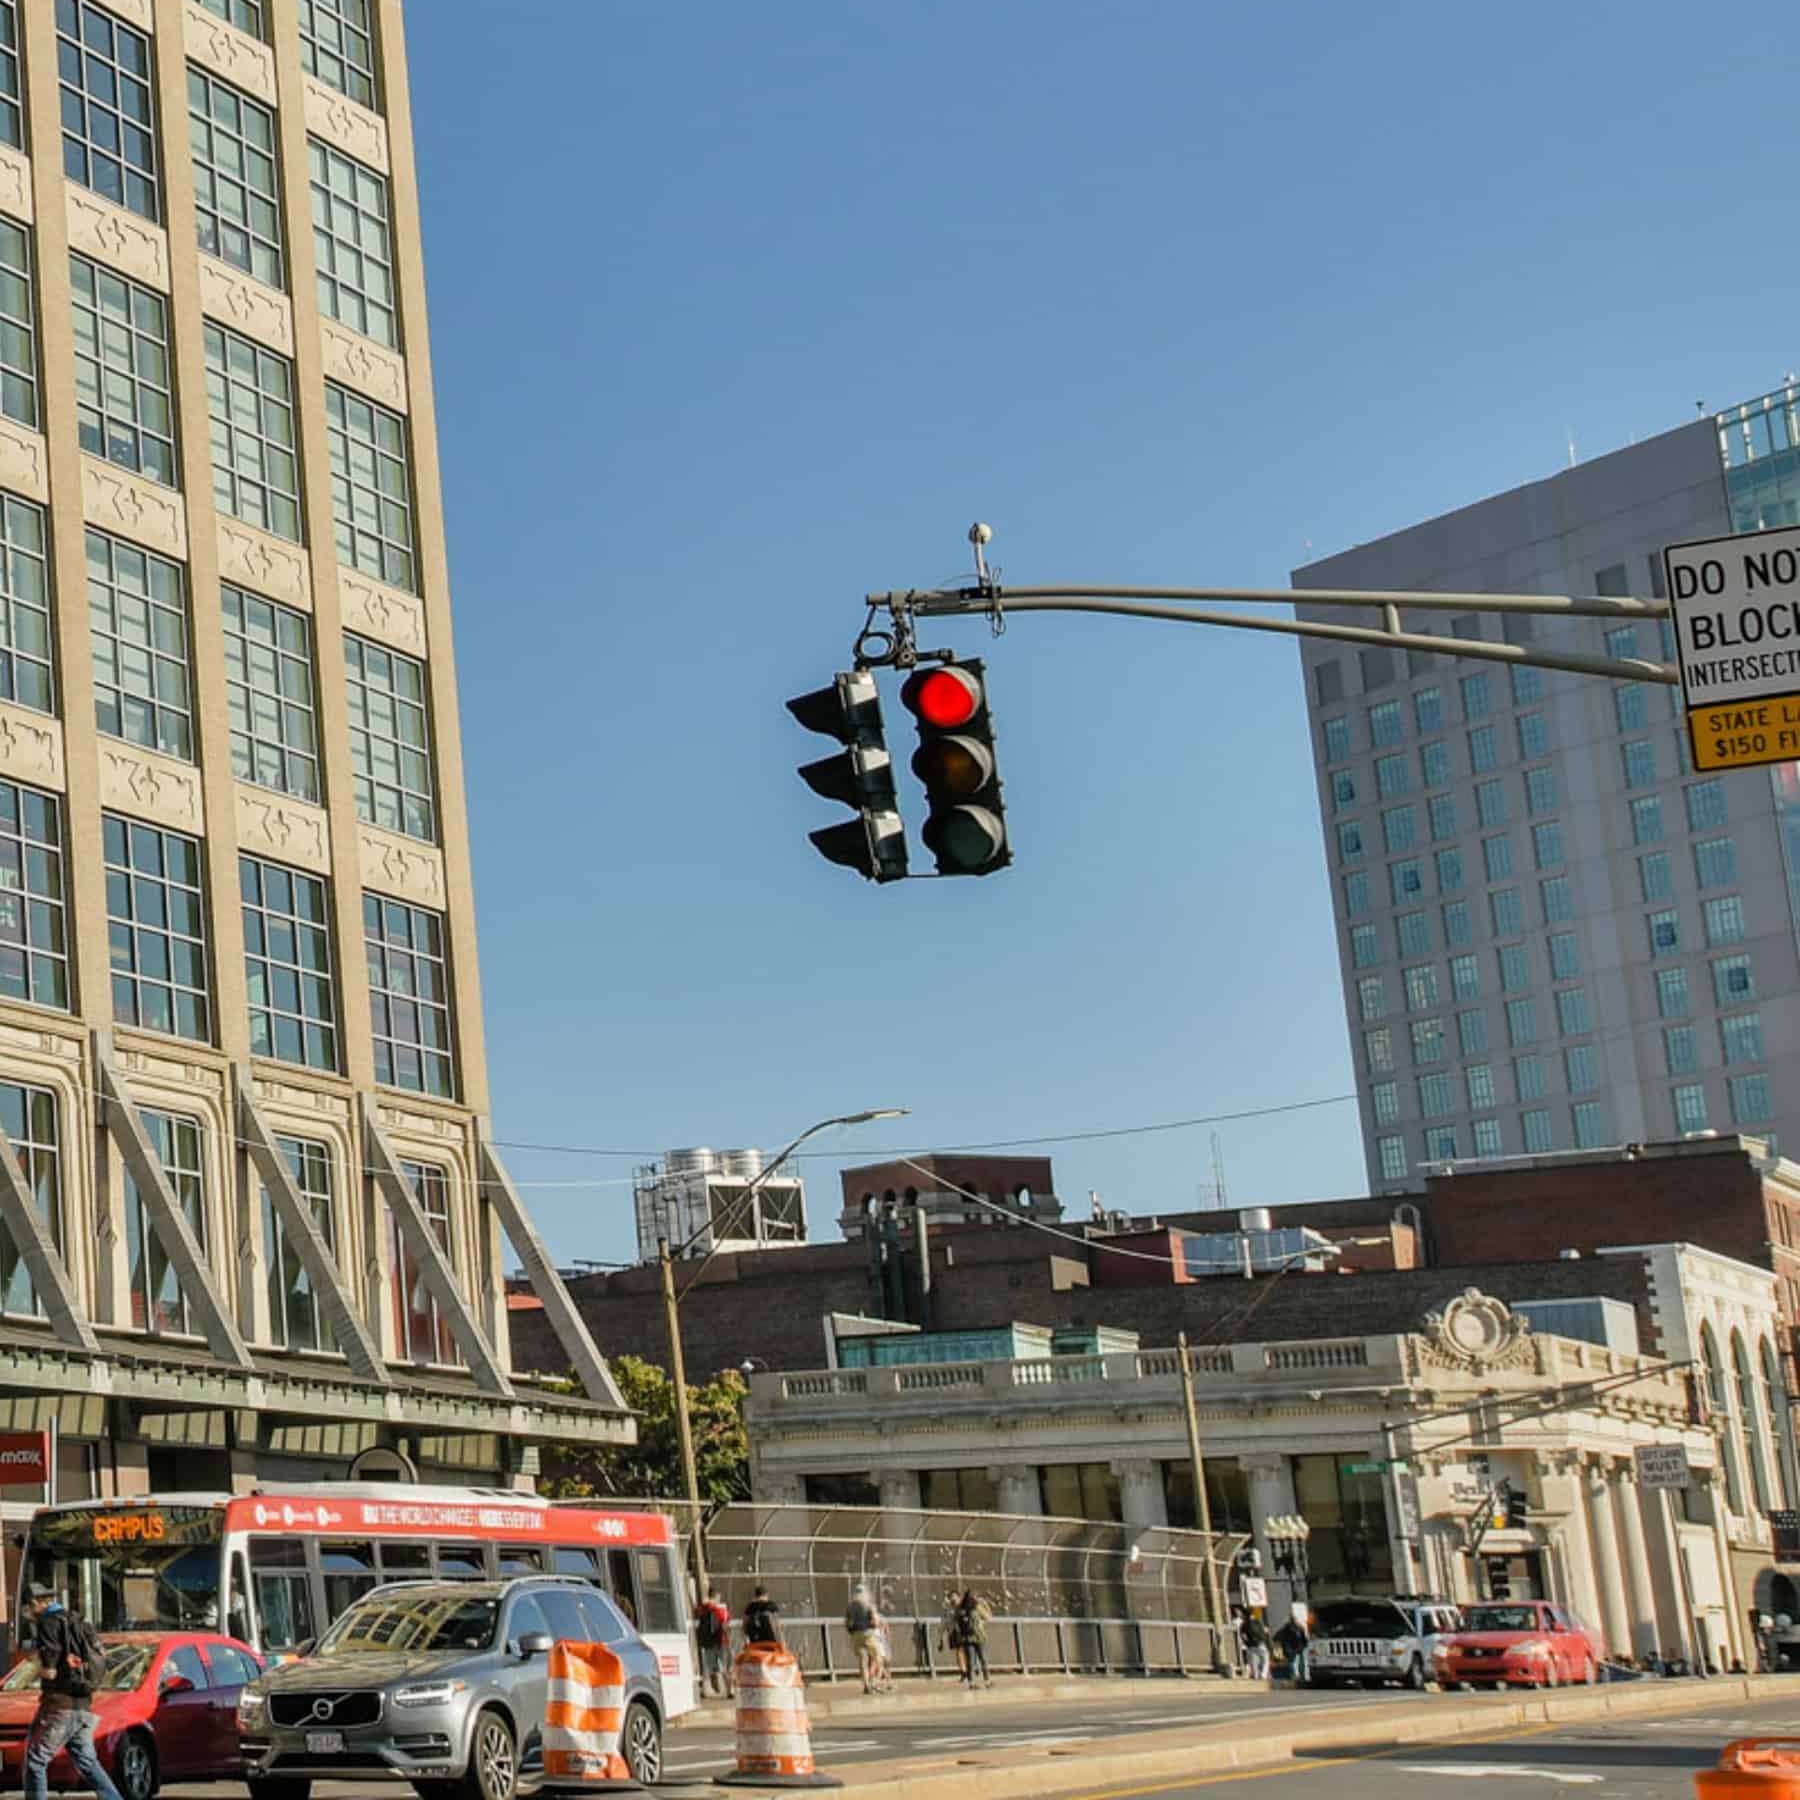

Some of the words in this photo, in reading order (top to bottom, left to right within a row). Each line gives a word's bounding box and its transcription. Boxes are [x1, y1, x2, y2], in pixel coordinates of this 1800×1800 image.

[1674, 560, 1725, 599] DO
[1743, 547, 1800, 590] NO
[1709, 708, 1769, 732] STATE
[1715, 735, 1766, 757] $150
[93, 1514, 165, 1542] CAMPUS
